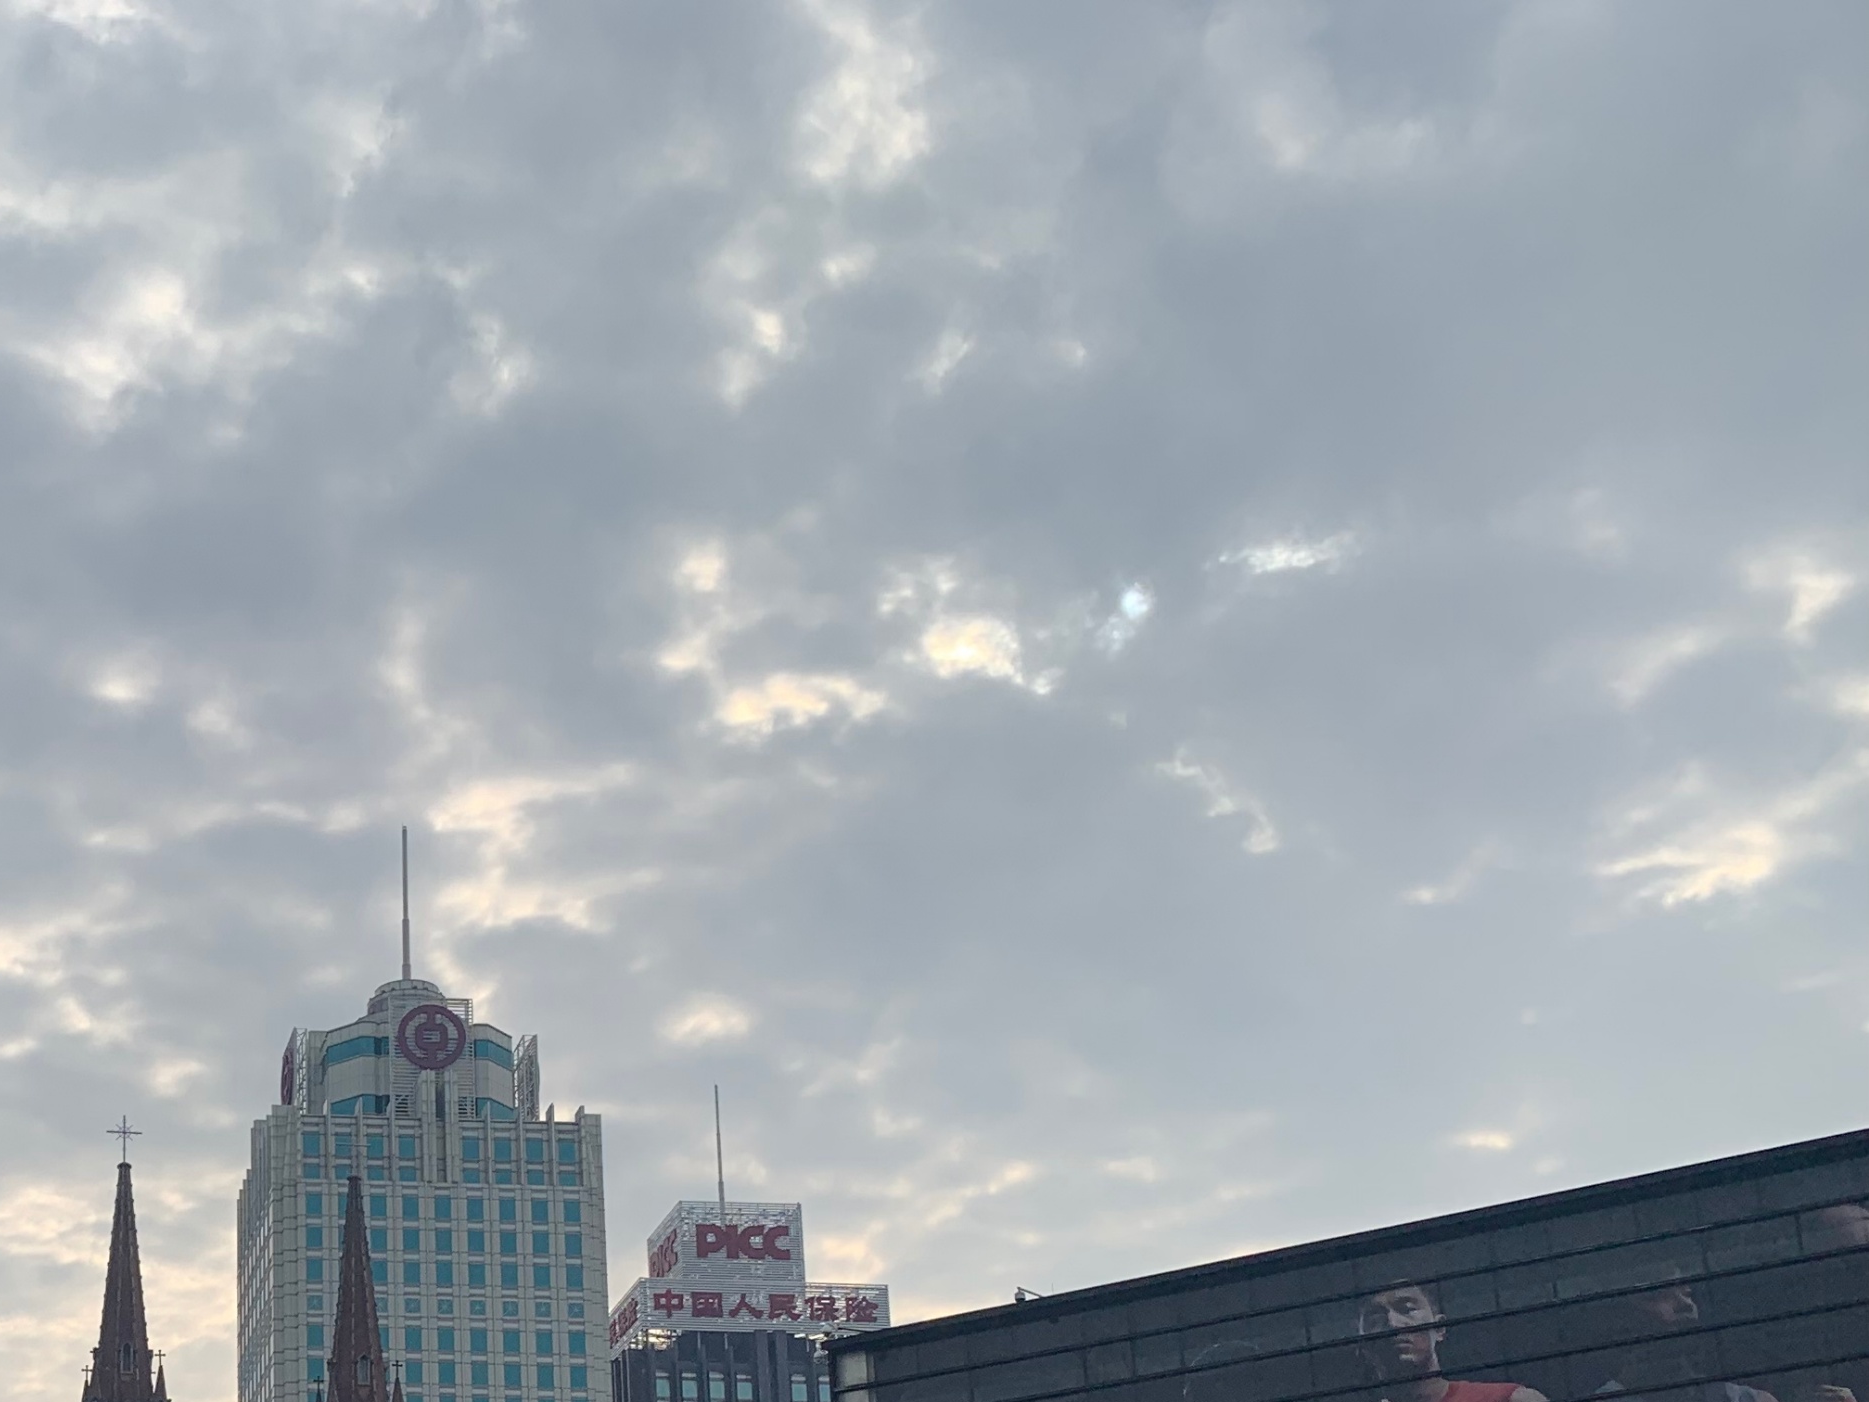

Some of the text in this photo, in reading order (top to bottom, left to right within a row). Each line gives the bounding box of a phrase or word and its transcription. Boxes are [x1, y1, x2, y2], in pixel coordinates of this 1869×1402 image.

[696, 1224, 791, 1260] PICC
[653, 1289, 879, 1323] 中国人民保险
